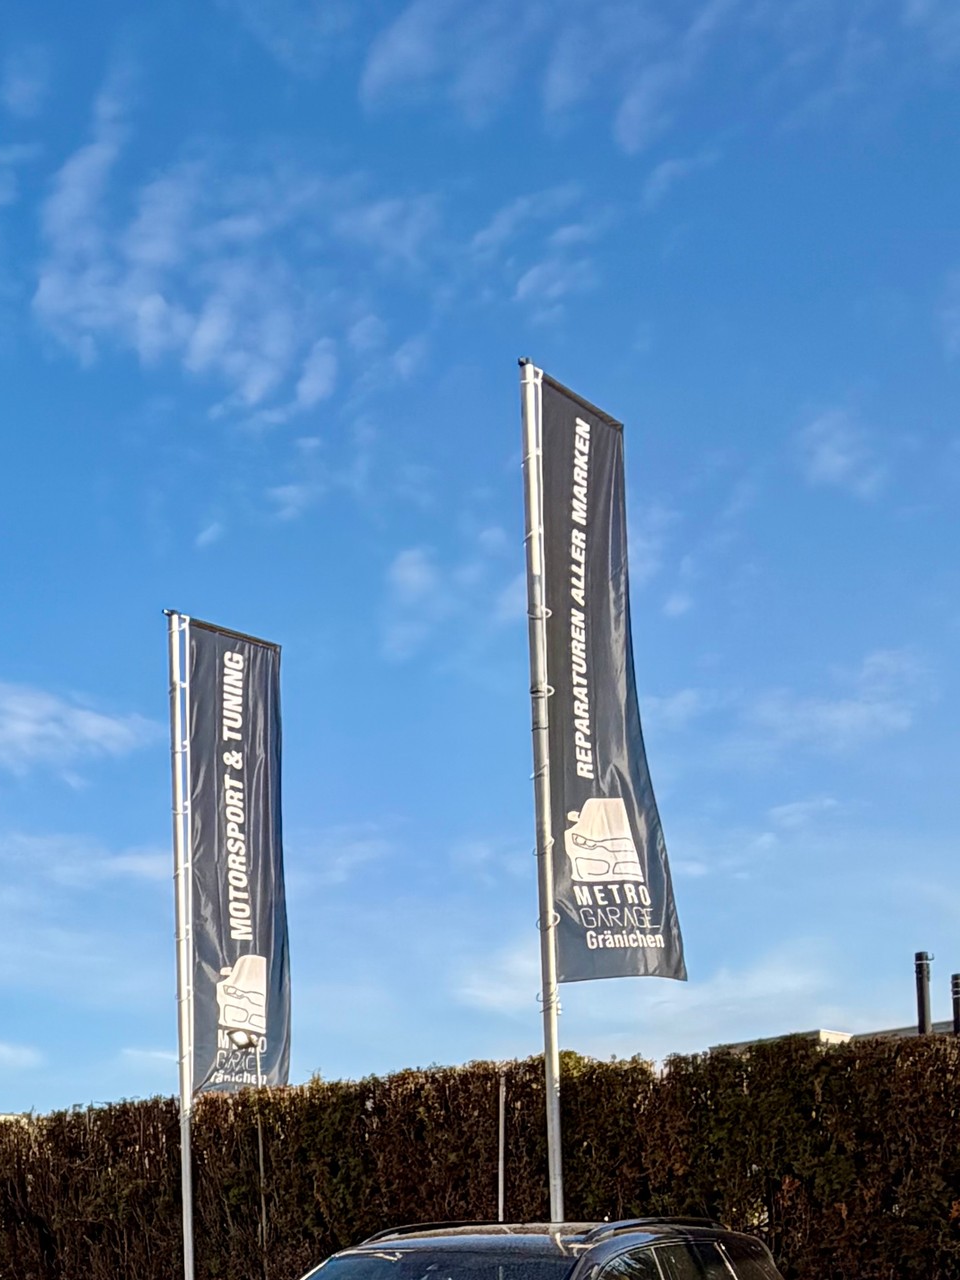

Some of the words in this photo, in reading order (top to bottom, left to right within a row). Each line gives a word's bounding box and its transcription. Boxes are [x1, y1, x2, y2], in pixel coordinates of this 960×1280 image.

[571, 417, 590, 526] MARKEN
[571, 528, 586, 607] ALLER
[223, 651, 244, 741] TUNING
[571, 608, 594, 780] REPARATUREN
[223, 750, 243, 770] &
[224, 774, 253, 942] MOTORSPORT
[573, 883, 651, 906] METRO
[580, 906, 660, 928] GARAGE
[586, 930, 665, 949] Gränichen
